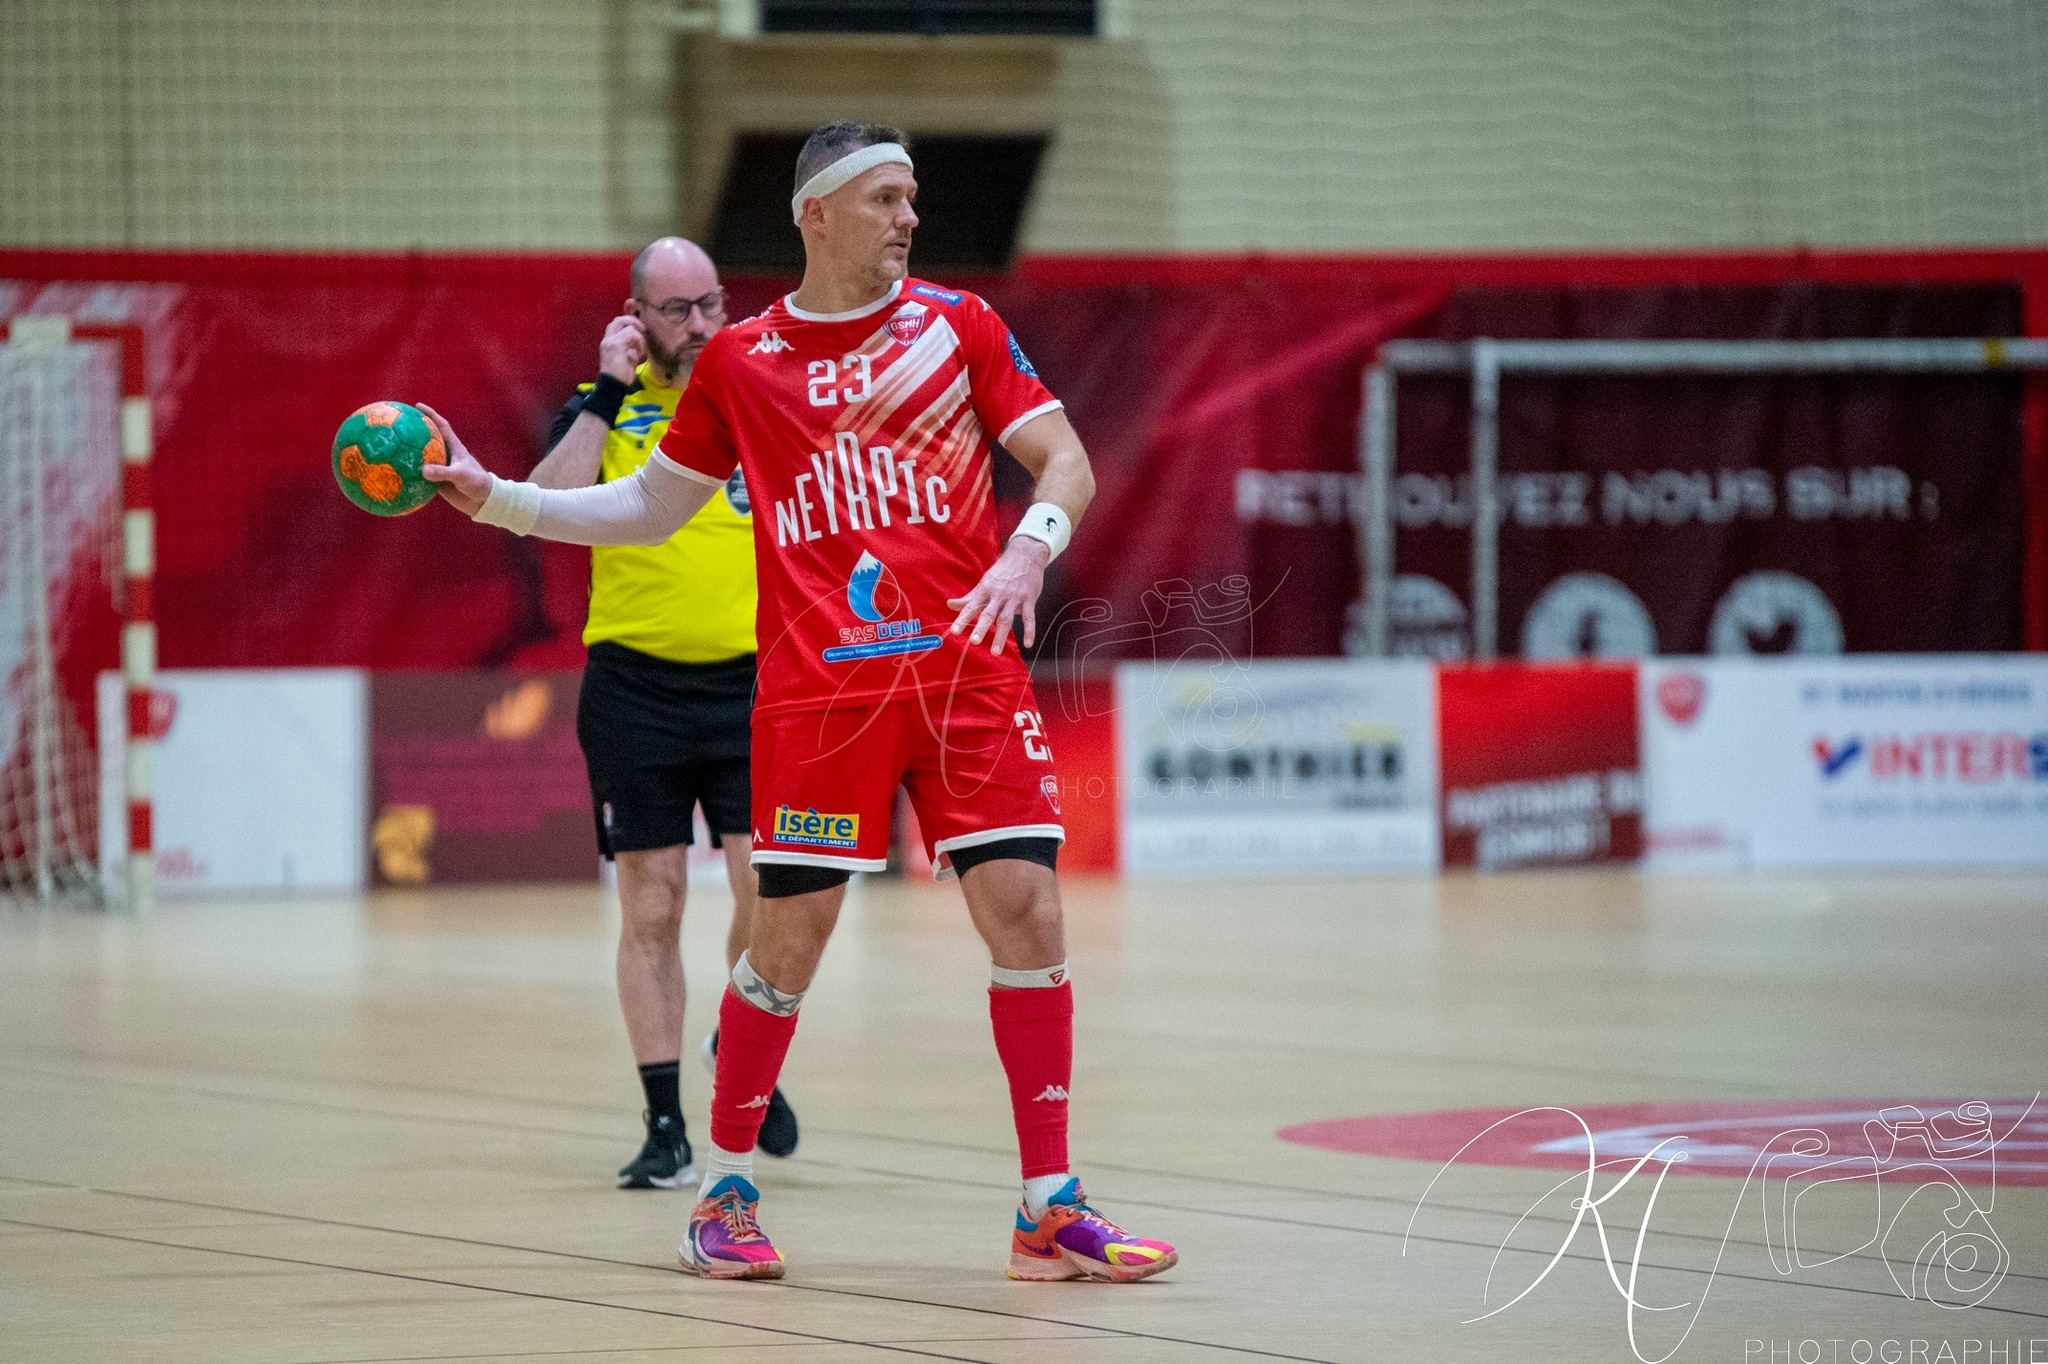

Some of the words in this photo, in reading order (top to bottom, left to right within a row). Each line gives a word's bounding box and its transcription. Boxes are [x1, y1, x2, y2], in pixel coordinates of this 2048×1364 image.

[890, 317, 920, 332] GSMH
[807, 353, 872, 407] 23
[774, 431, 950, 548] NEYRPIC
[1236, 469, 1588, 526] RETOUEZ
[839, 625, 877, 645] SAS
[876, 618, 921, 640] DEMI
[779, 805, 853, 837] isère
[788, 836, 855, 847] DÉPARTEMENT
